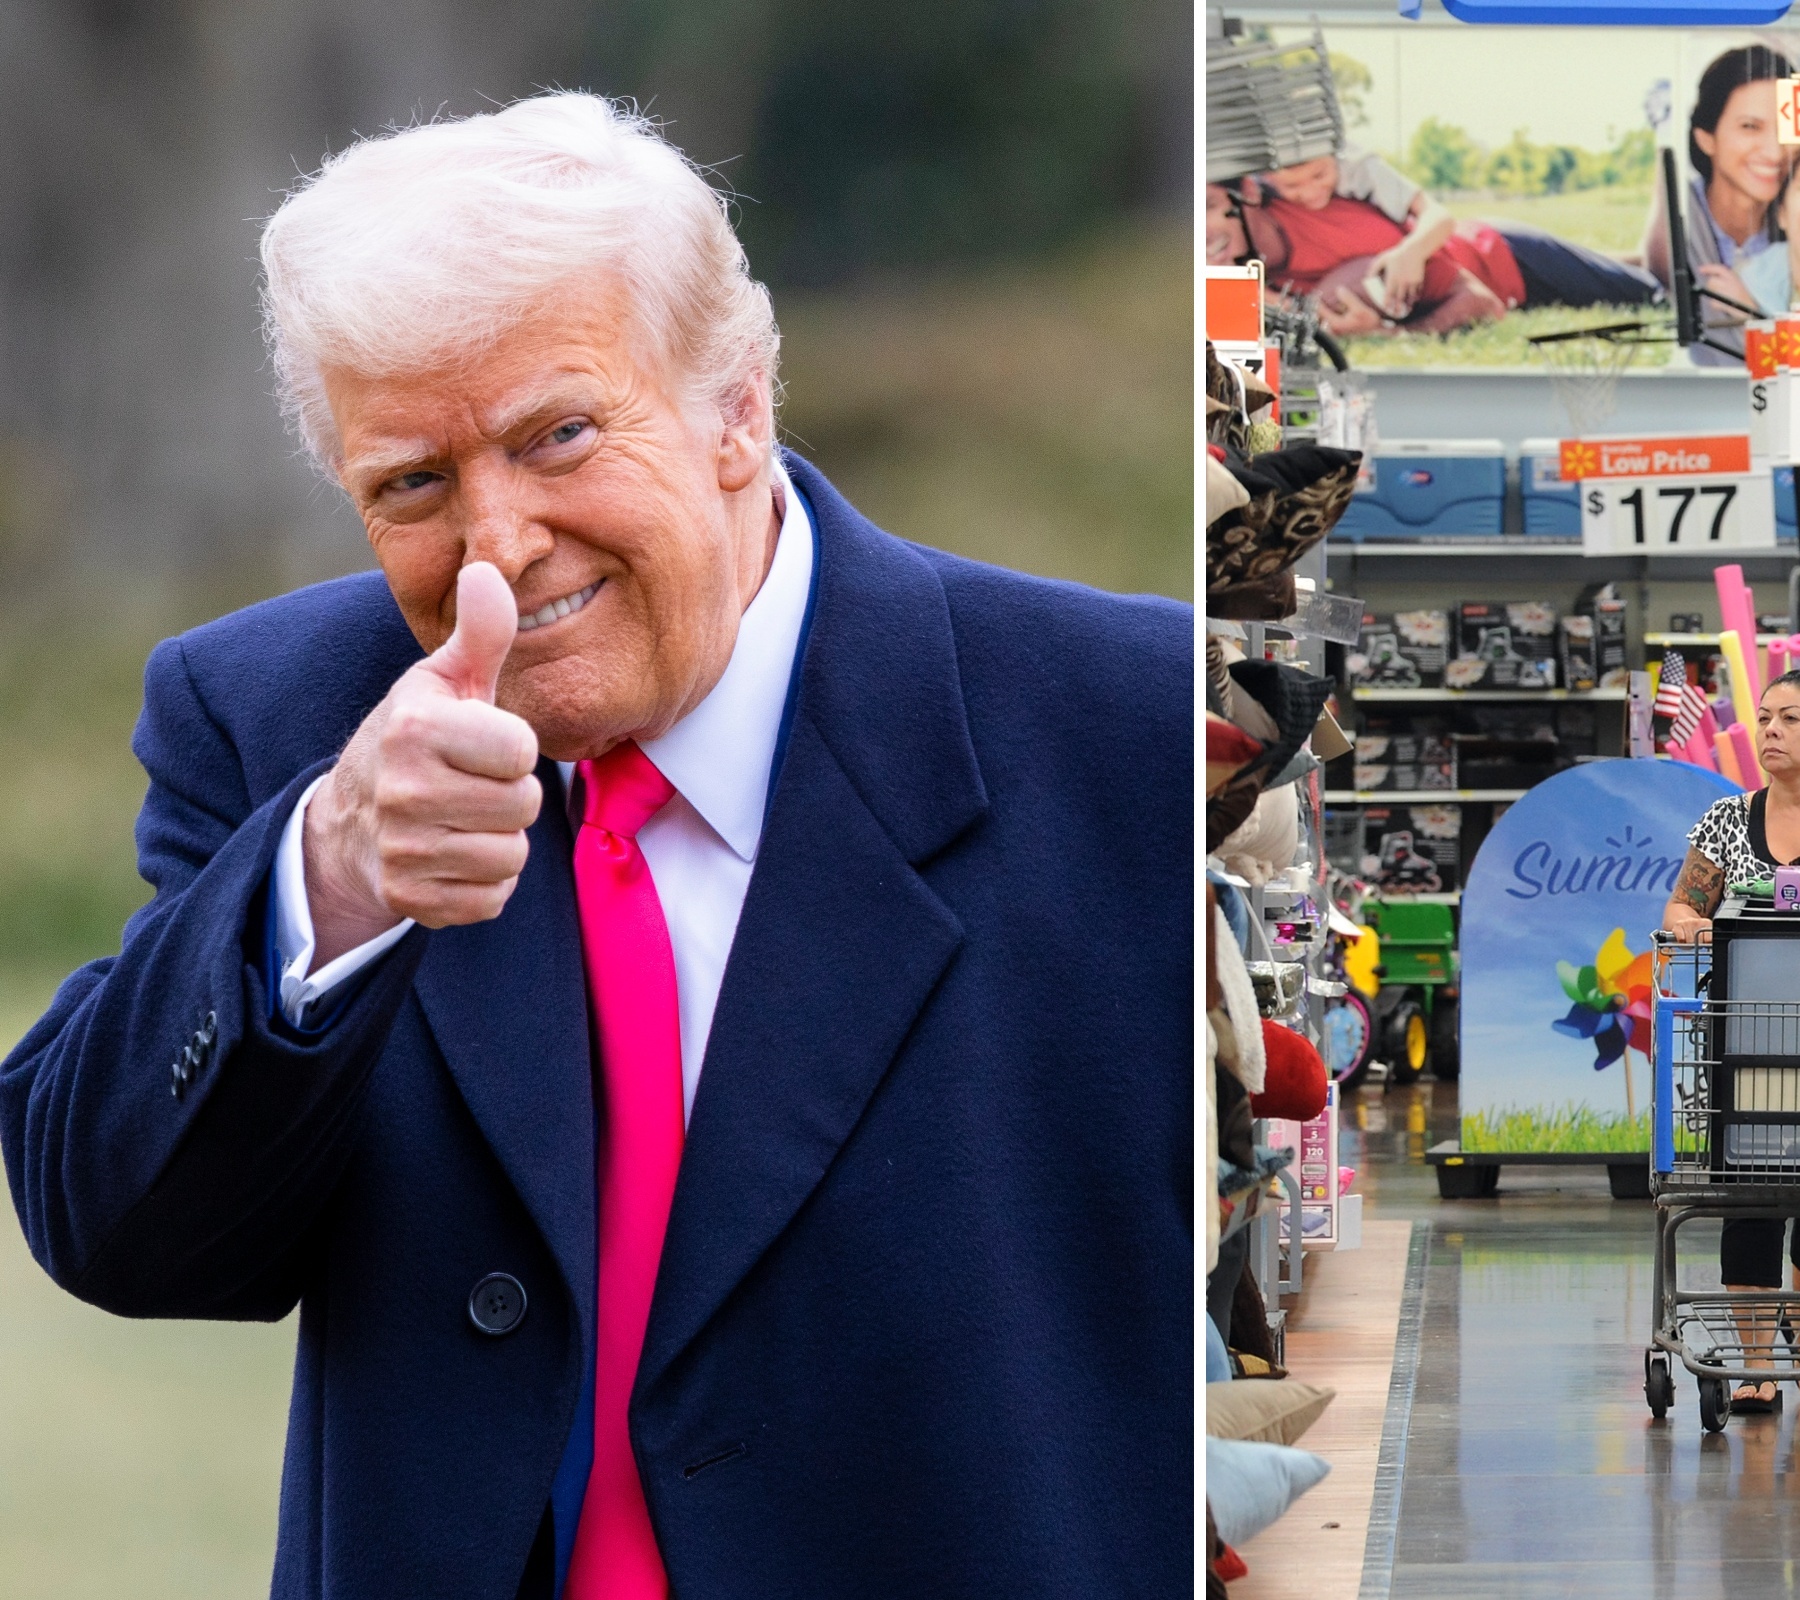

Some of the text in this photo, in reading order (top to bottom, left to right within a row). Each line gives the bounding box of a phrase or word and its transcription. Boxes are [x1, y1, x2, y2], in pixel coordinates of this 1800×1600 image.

[1602, 449, 1711, 474] Low Price
[1506, 841, 1683, 899] Summ
[1311, 1131, 1318, 1139] 5
[1306, 1148, 1324, 1156] 120
